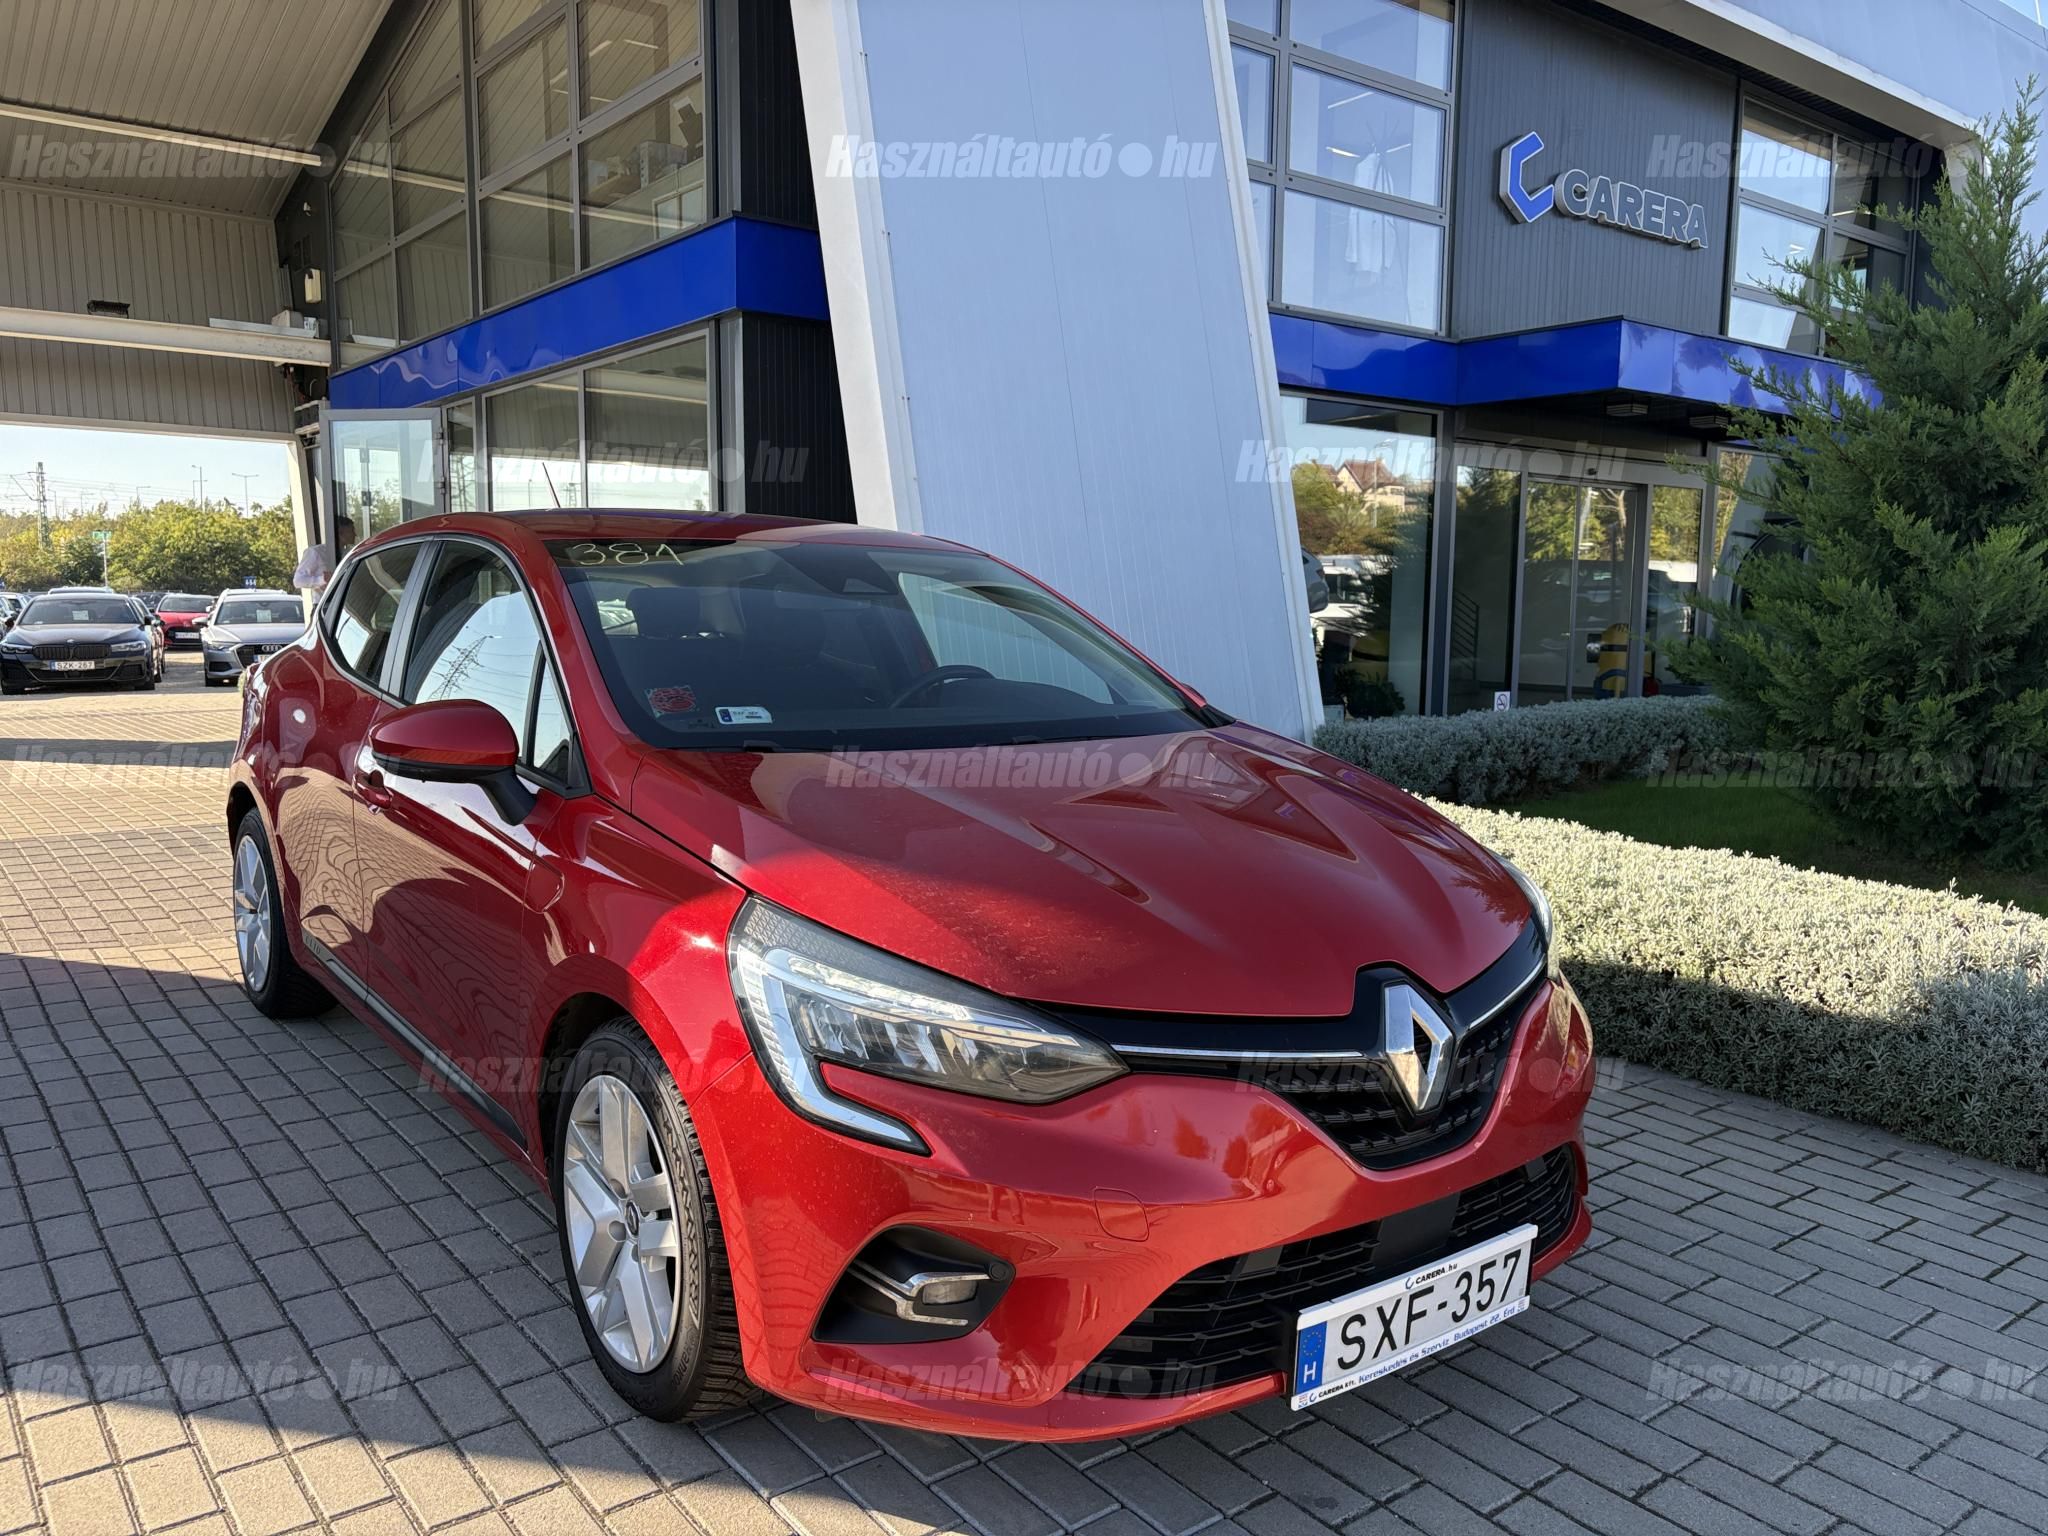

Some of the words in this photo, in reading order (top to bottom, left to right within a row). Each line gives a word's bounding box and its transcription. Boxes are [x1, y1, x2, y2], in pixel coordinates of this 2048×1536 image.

[1555, 168, 1708, 248] CARERA
[1337, 1248, 1522, 1370] SXF-357
[1303, 1361, 1317, 1384] H
[1318, 1385, 1344, 1398] CARERA
[1421, 1338, 1449, 1356] Szerviz
[1454, 1320, 1488, 1341] Budapest
